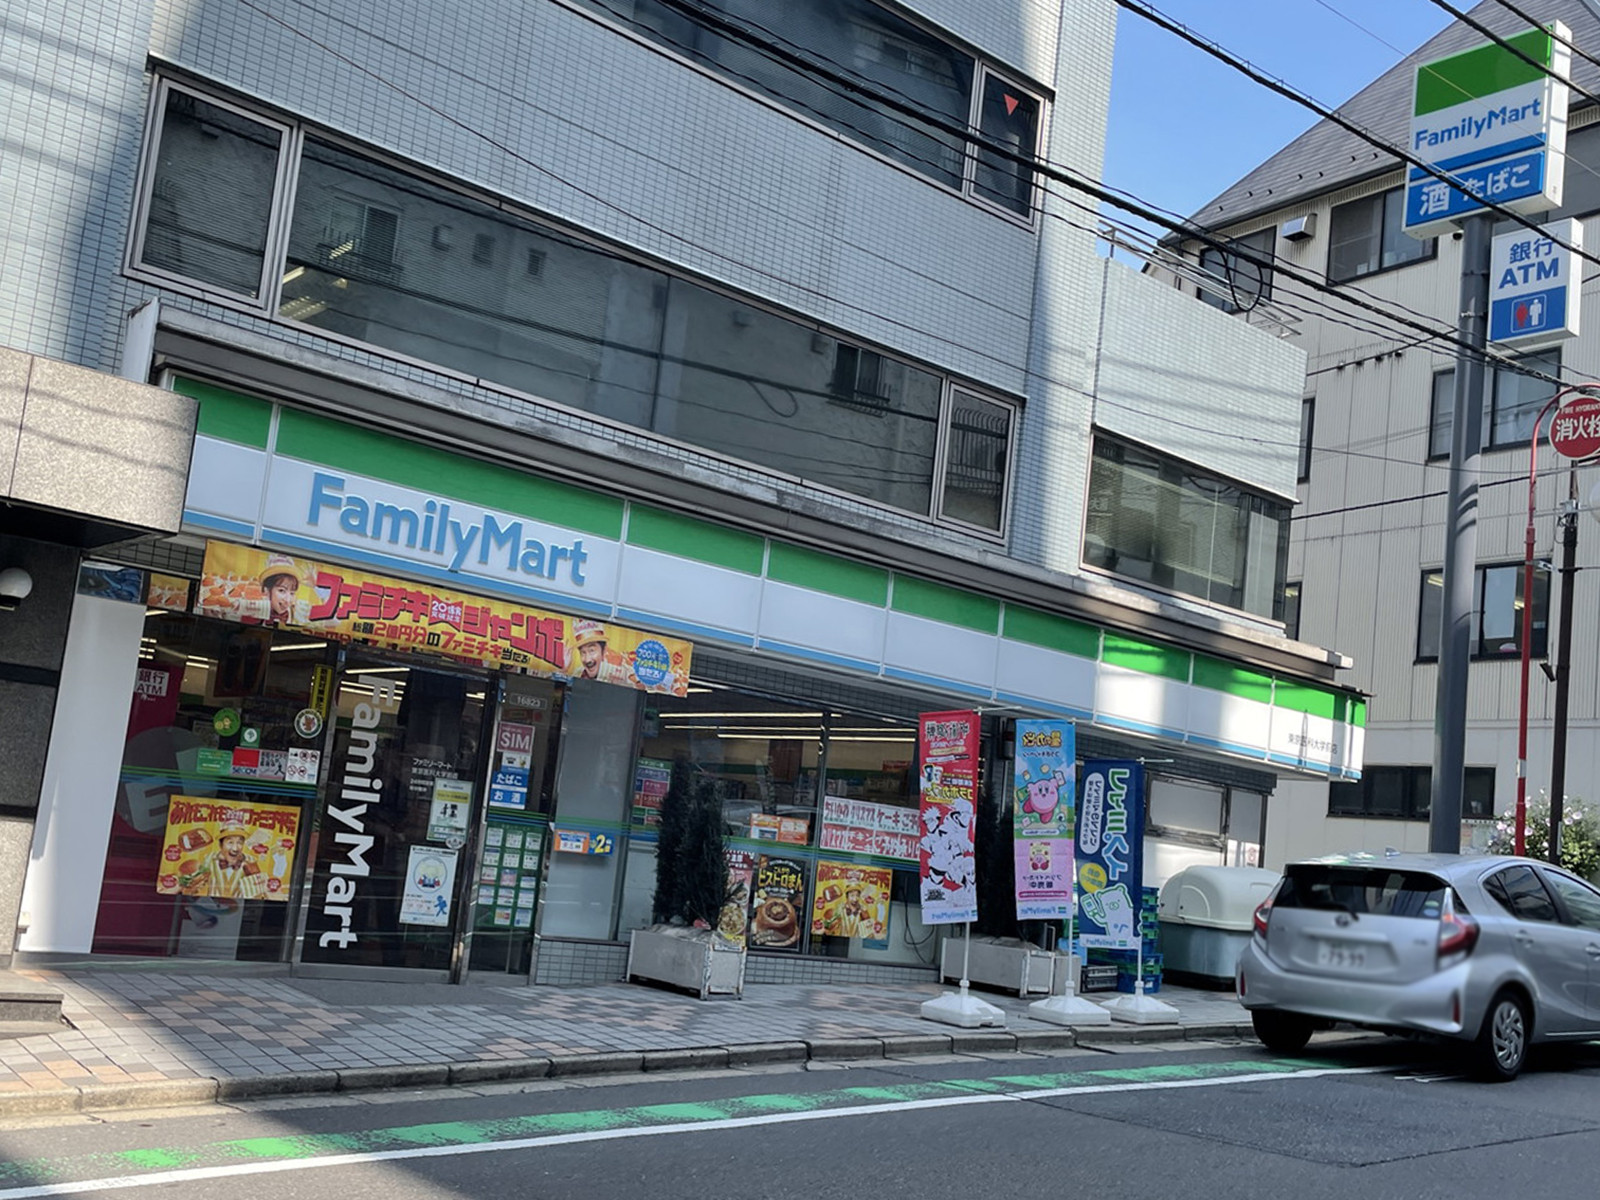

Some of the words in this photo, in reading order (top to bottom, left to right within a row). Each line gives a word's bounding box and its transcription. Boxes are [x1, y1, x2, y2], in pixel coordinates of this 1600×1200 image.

[1414, 98, 1541, 151] FamilyMart
[1420, 183, 1450, 216] 酒
[1461, 163, 1531, 202] たばこ
[1509, 237, 1555, 264] 銀行
[1498, 257, 1559, 290] ATM
[307, 471, 588, 585] FamilyMart
[308, 570, 431, 624] ファミチキ
[462, 605, 565, 669] ジャンボ
[136, 683, 162, 696] ATM
[138, 669, 165, 685] 銀行
[500, 730, 531, 751] SIM
[412, 757, 453, 771] ファミリーマート
[496, 773, 523, 786] たばこ
[319, 675, 396, 949] FamilyMart
[758, 868, 803, 892] ビストロまん
